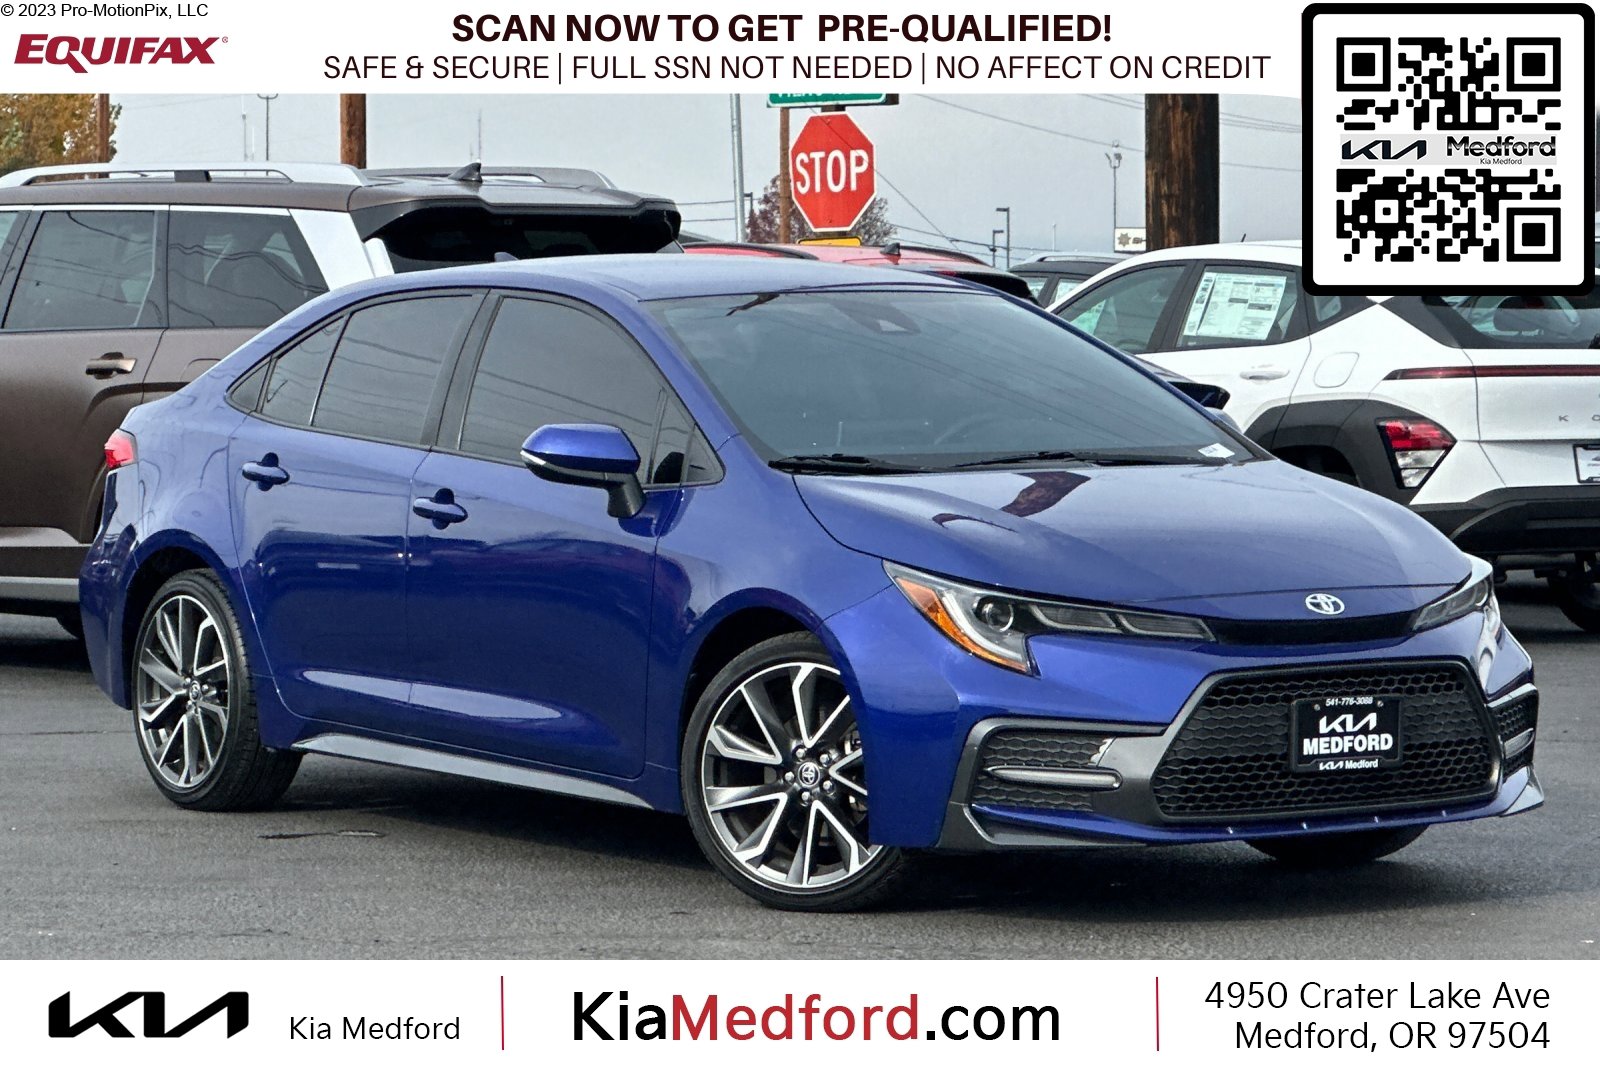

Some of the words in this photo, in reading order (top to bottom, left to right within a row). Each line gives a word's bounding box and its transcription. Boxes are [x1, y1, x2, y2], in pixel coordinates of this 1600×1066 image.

[795, 149, 870, 195] STOP
[1319, 712, 1378, 734] KIA
[1302, 733, 1394, 756] MEDFORD
[1345, 758, 1379, 770] Medford
